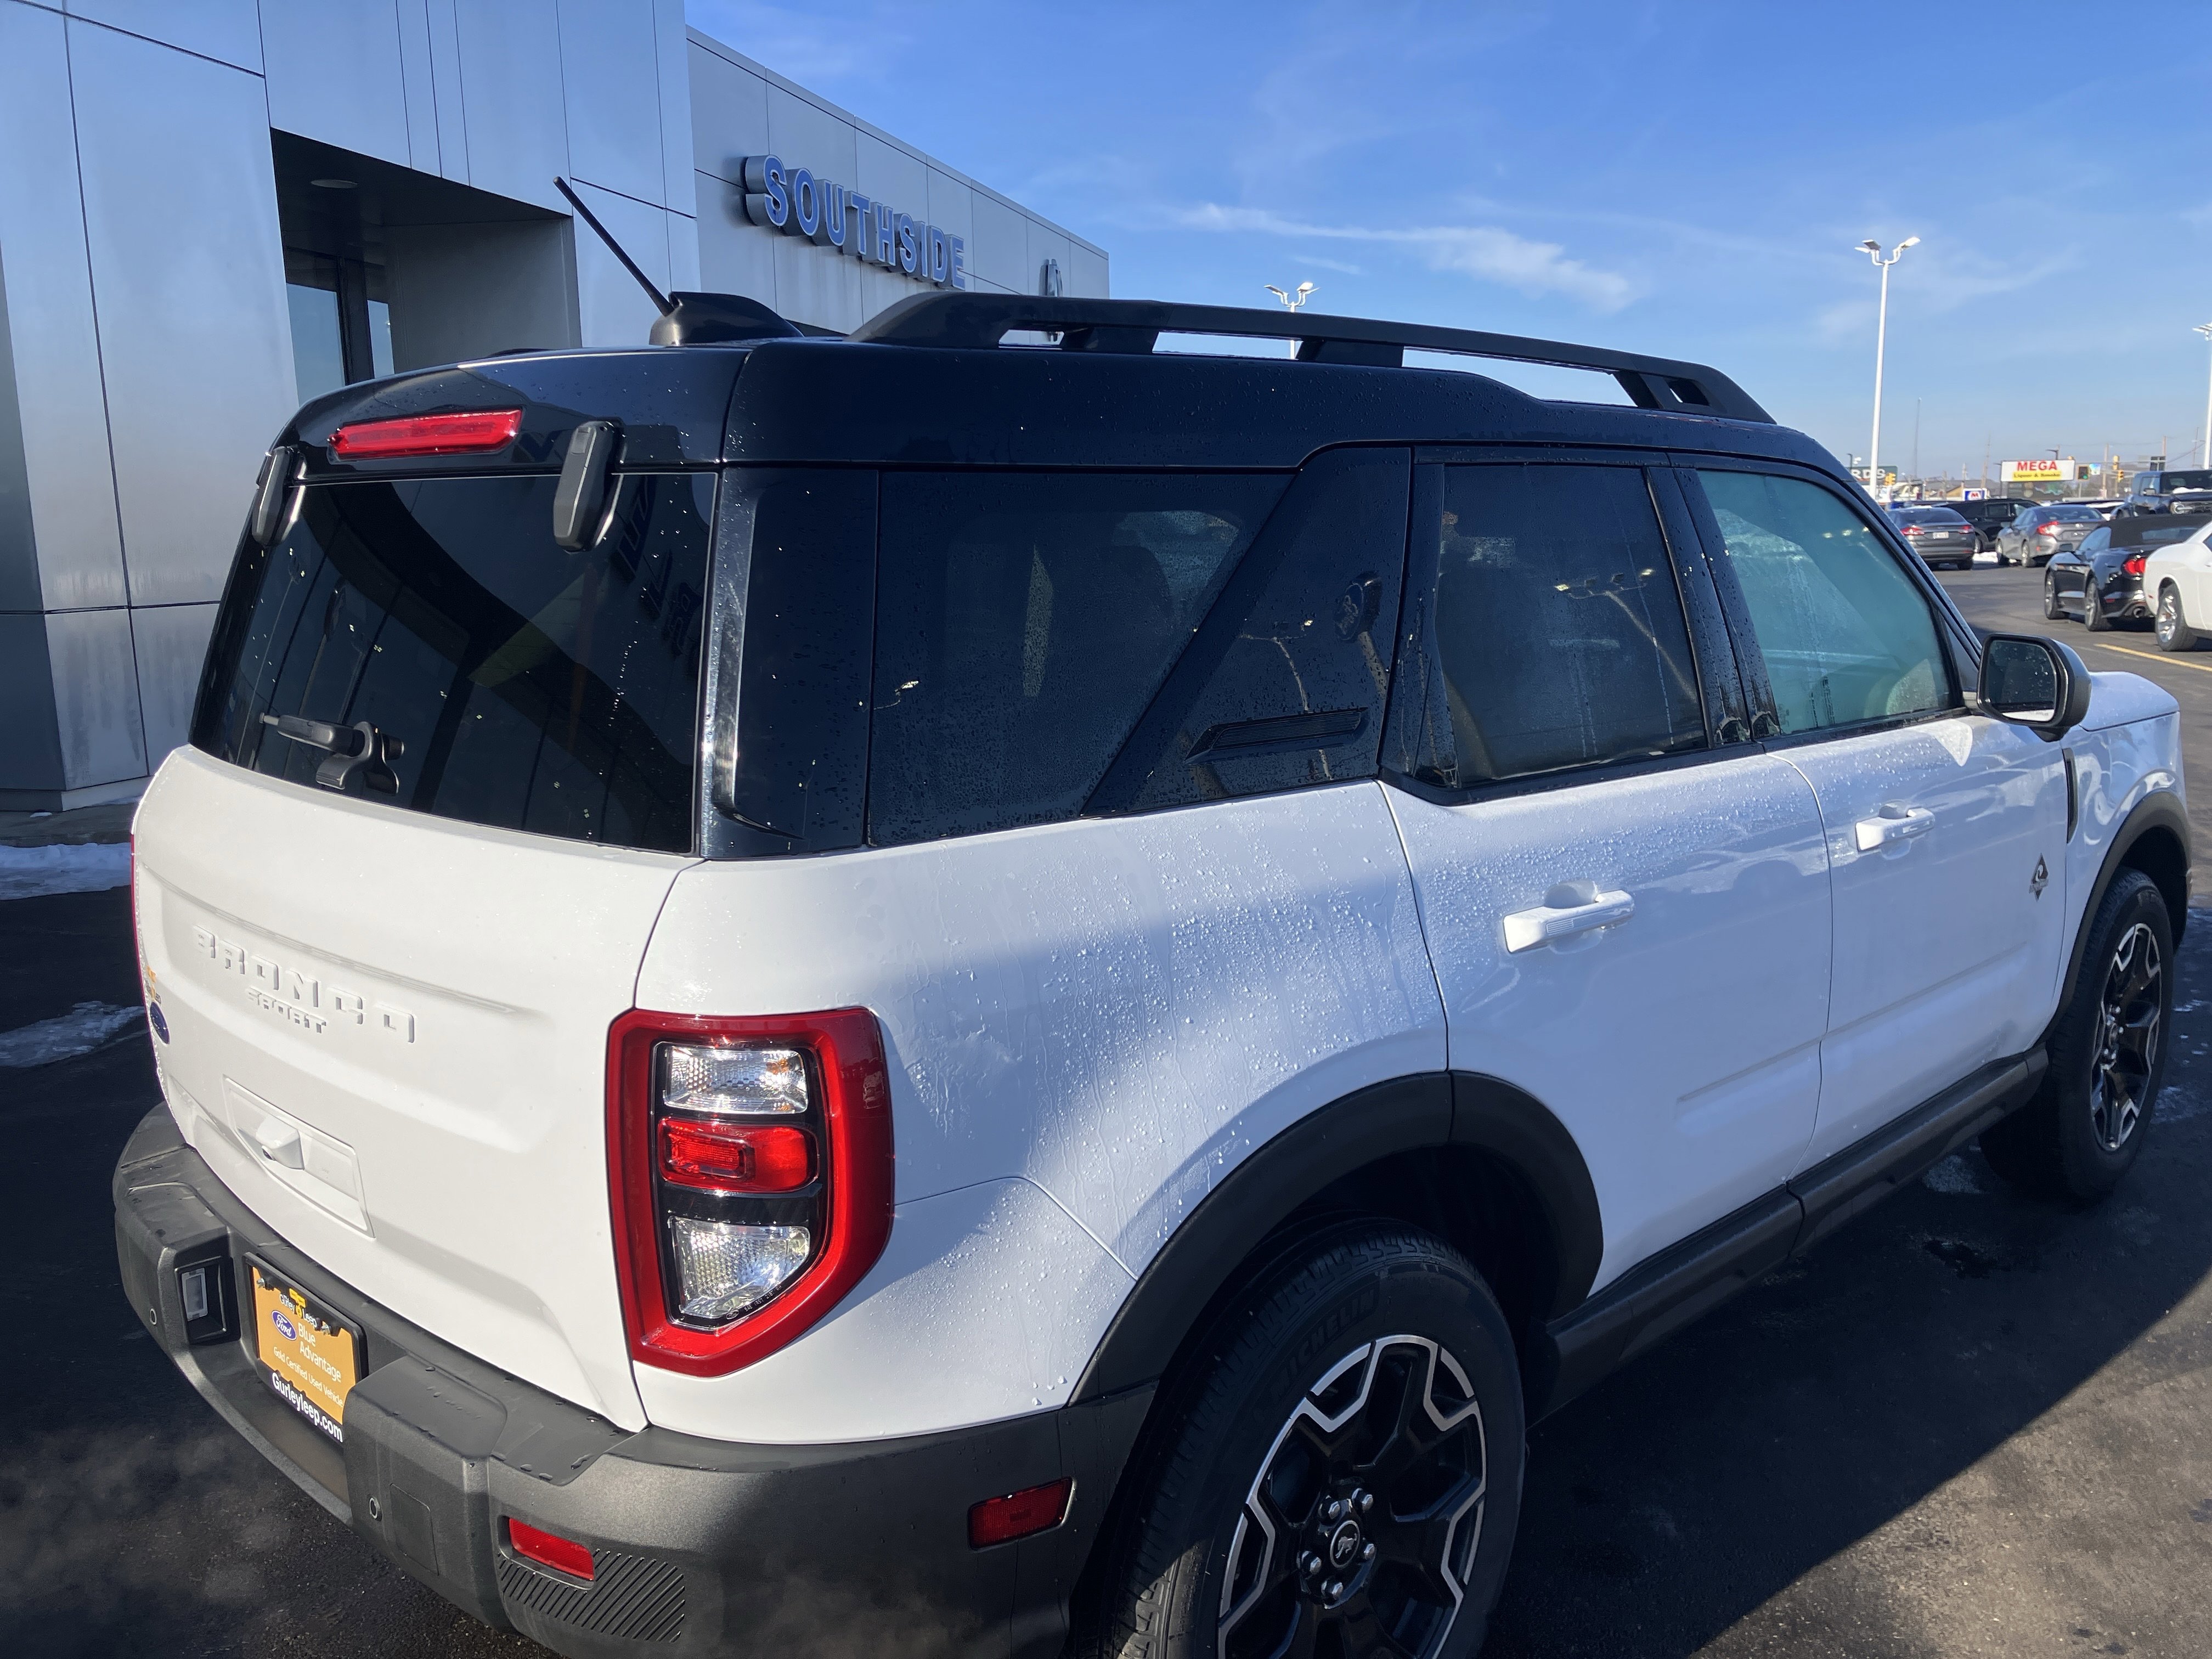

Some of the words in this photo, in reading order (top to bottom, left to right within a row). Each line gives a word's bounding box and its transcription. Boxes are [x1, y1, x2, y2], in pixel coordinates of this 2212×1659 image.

[747, 154, 965, 291] SOUTHSIDE
[2017, 460, 2057, 471] MEGA
[194, 925, 417, 1043] BRONCO
[245, 986, 328, 1034] SPORT
[275, 1313, 292, 1337] Ford
[298, 1322, 316, 1347] Blue
[1270, 1289, 1375, 1394] MICHELIN
[274, 1346, 285, 1363] Gold
[286, 1356, 308, 1381] Certified
[308, 1373, 323, 1391] Used
[323, 1384, 343, 1408] Vehicle
[300, 1341, 341, 1383] Advantage
[272, 1372, 343, 1443] Gurleyleep.com
